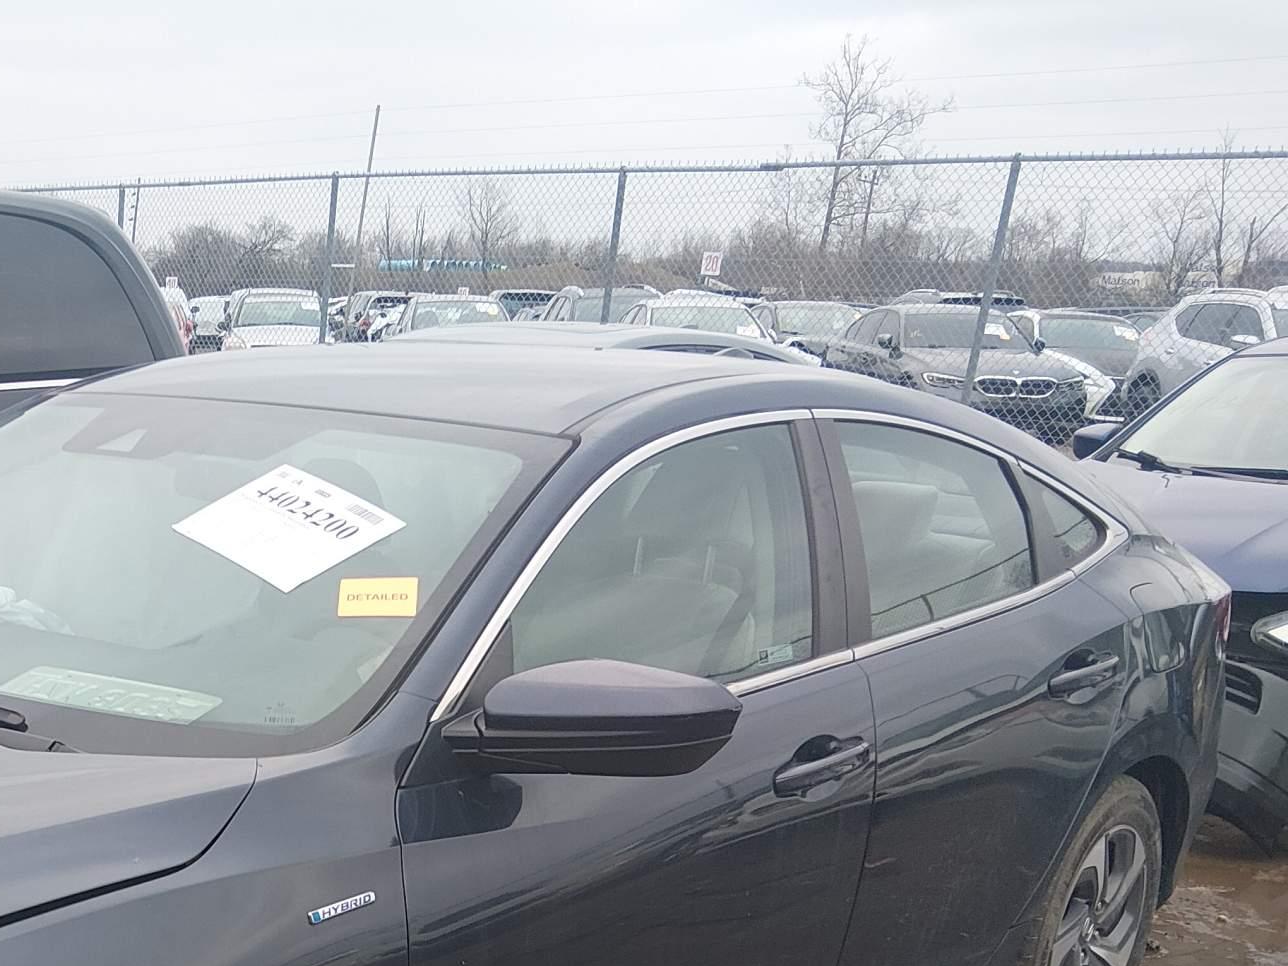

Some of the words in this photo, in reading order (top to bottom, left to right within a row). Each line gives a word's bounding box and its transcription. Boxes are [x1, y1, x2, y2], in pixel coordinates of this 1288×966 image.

[705, 255, 719, 272] 20
[1101, 275, 1141, 287] Matson
[257, 486, 359, 540] 44024200
[347, 592, 409, 602] DETAILED
[322, 894, 372, 919] HYBRID
